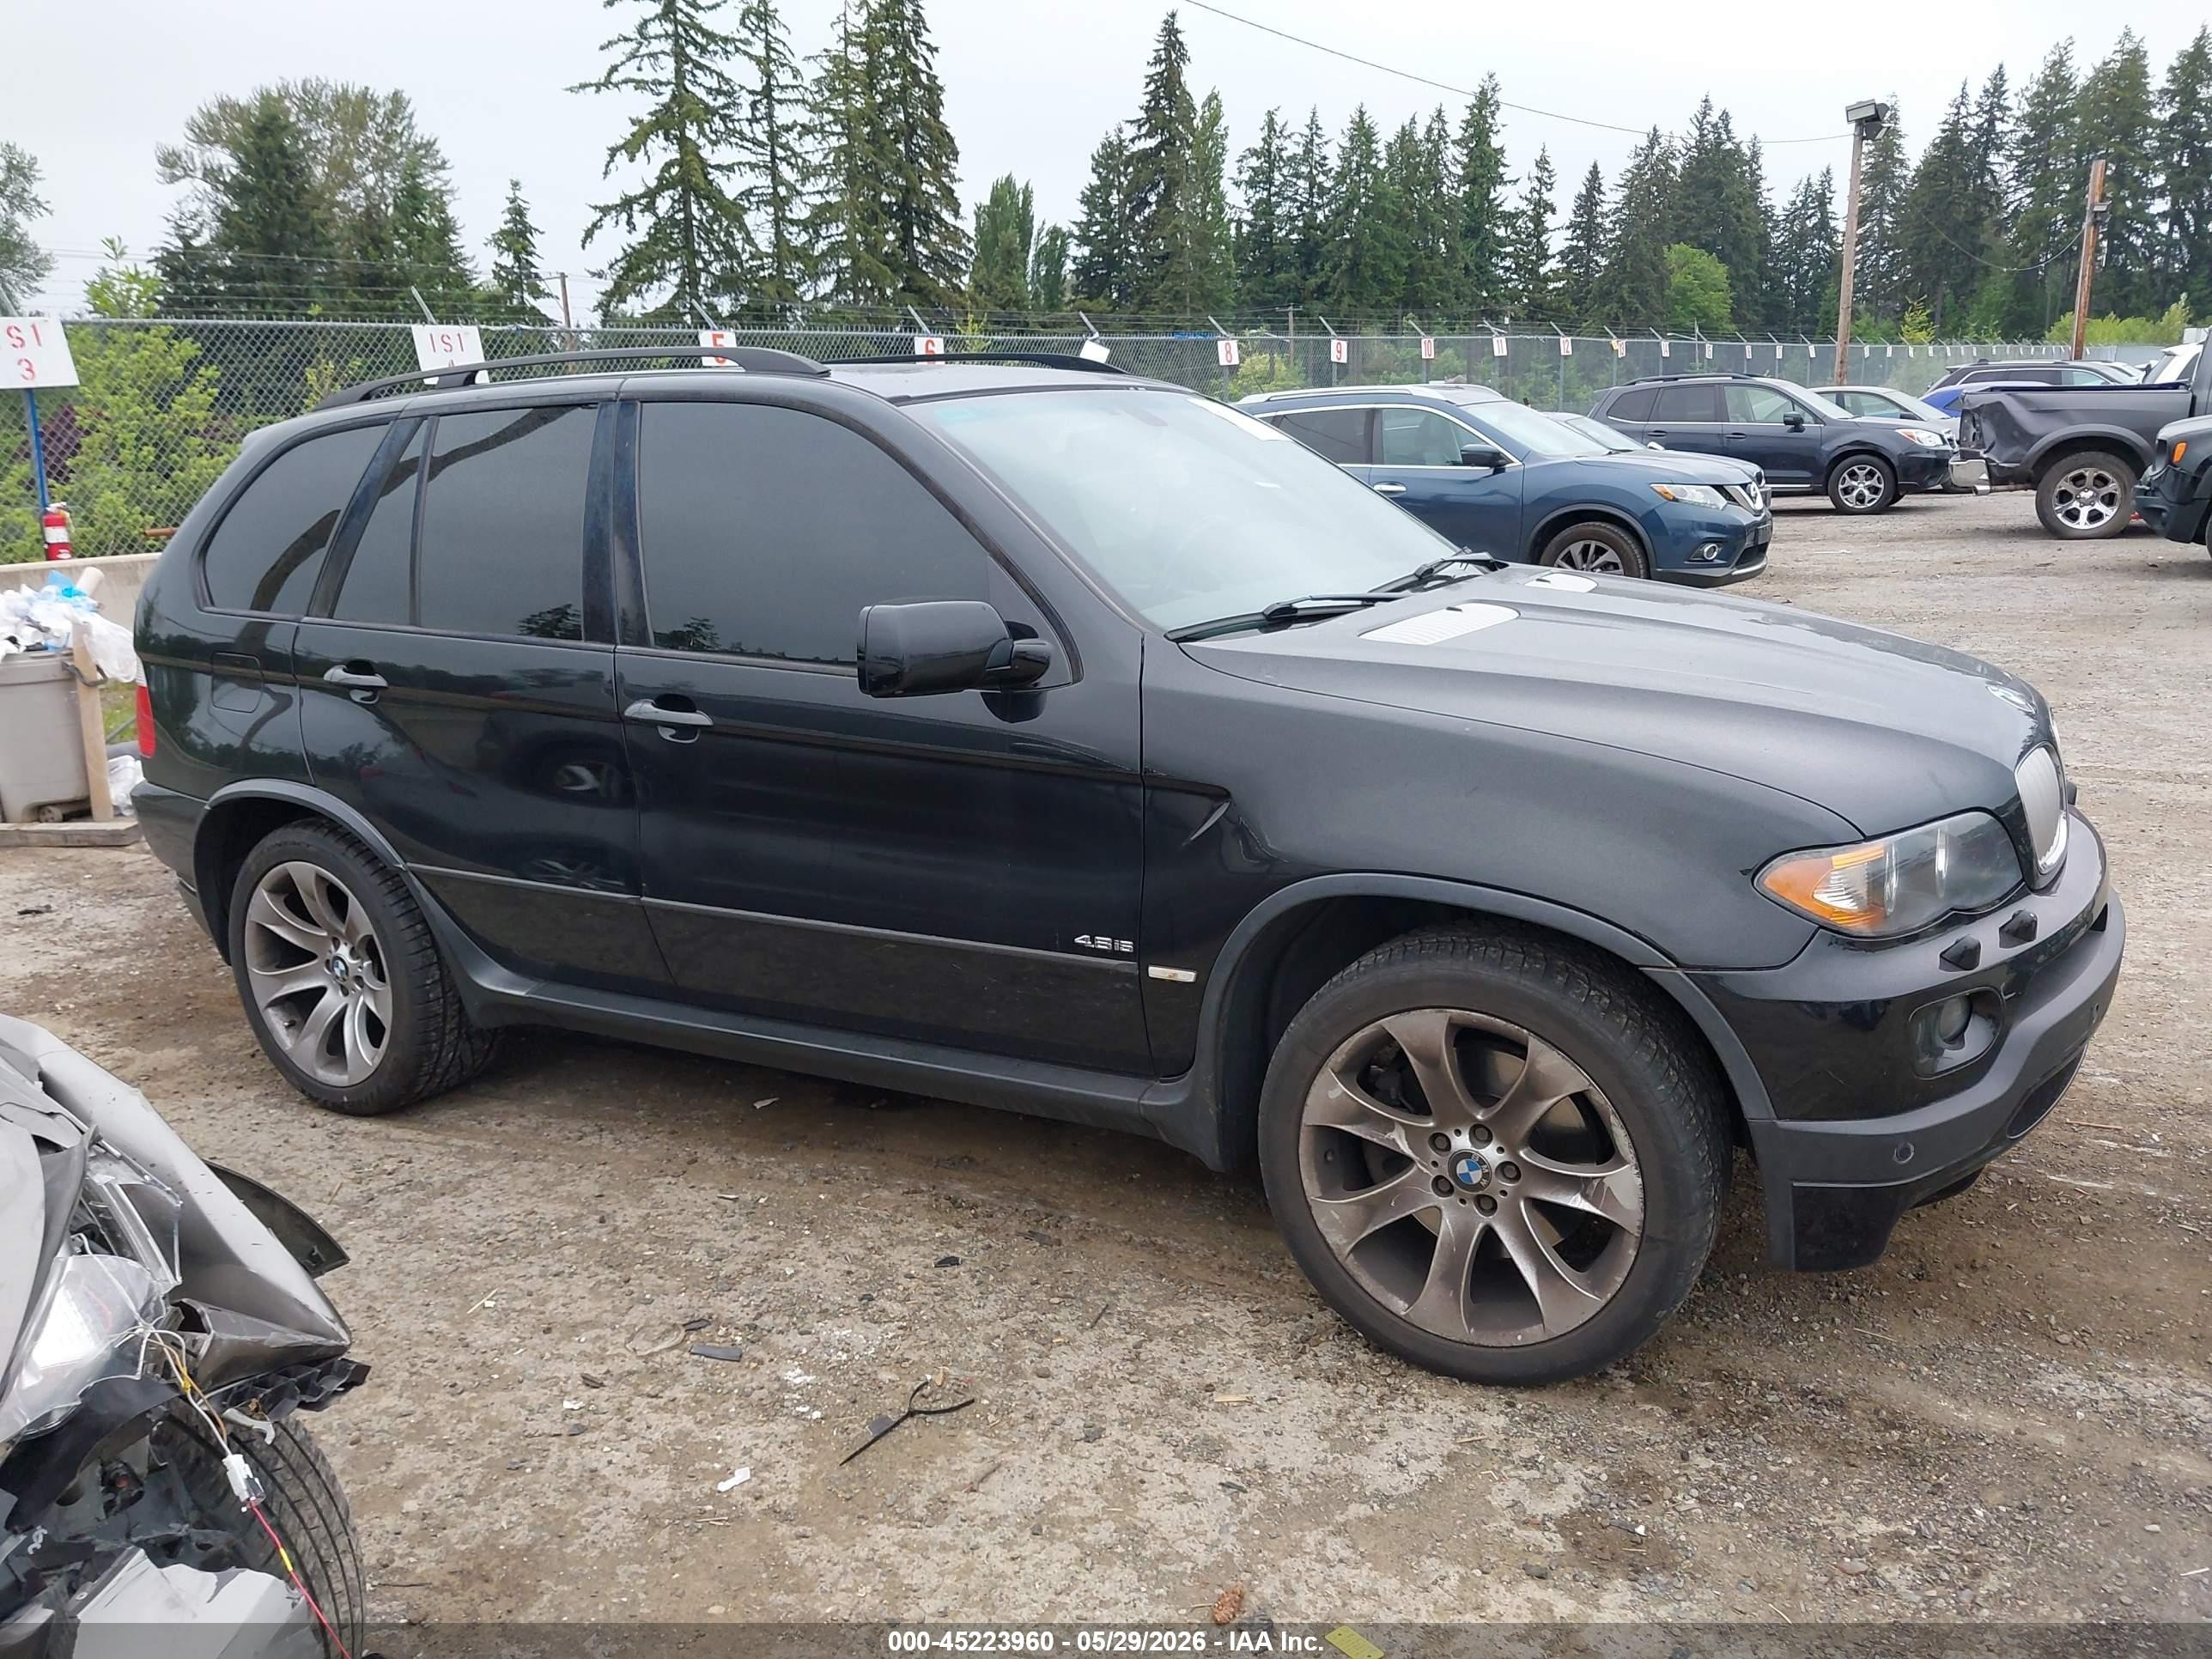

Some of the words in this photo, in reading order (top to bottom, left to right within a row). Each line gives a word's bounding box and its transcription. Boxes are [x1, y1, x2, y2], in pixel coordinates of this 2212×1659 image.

[712, 333, 726, 364] 5
[1224, 342, 1233, 363] 8
[1335, 342, 1342, 361] 9
[1423, 339, 1432, 357] 10
[1496, 338, 1504, 355] 11
[1561, 339, 1571, 354] 12
[17, 358, 35, 380] 3
[1471, 1153, 1490, 1188] BMW
